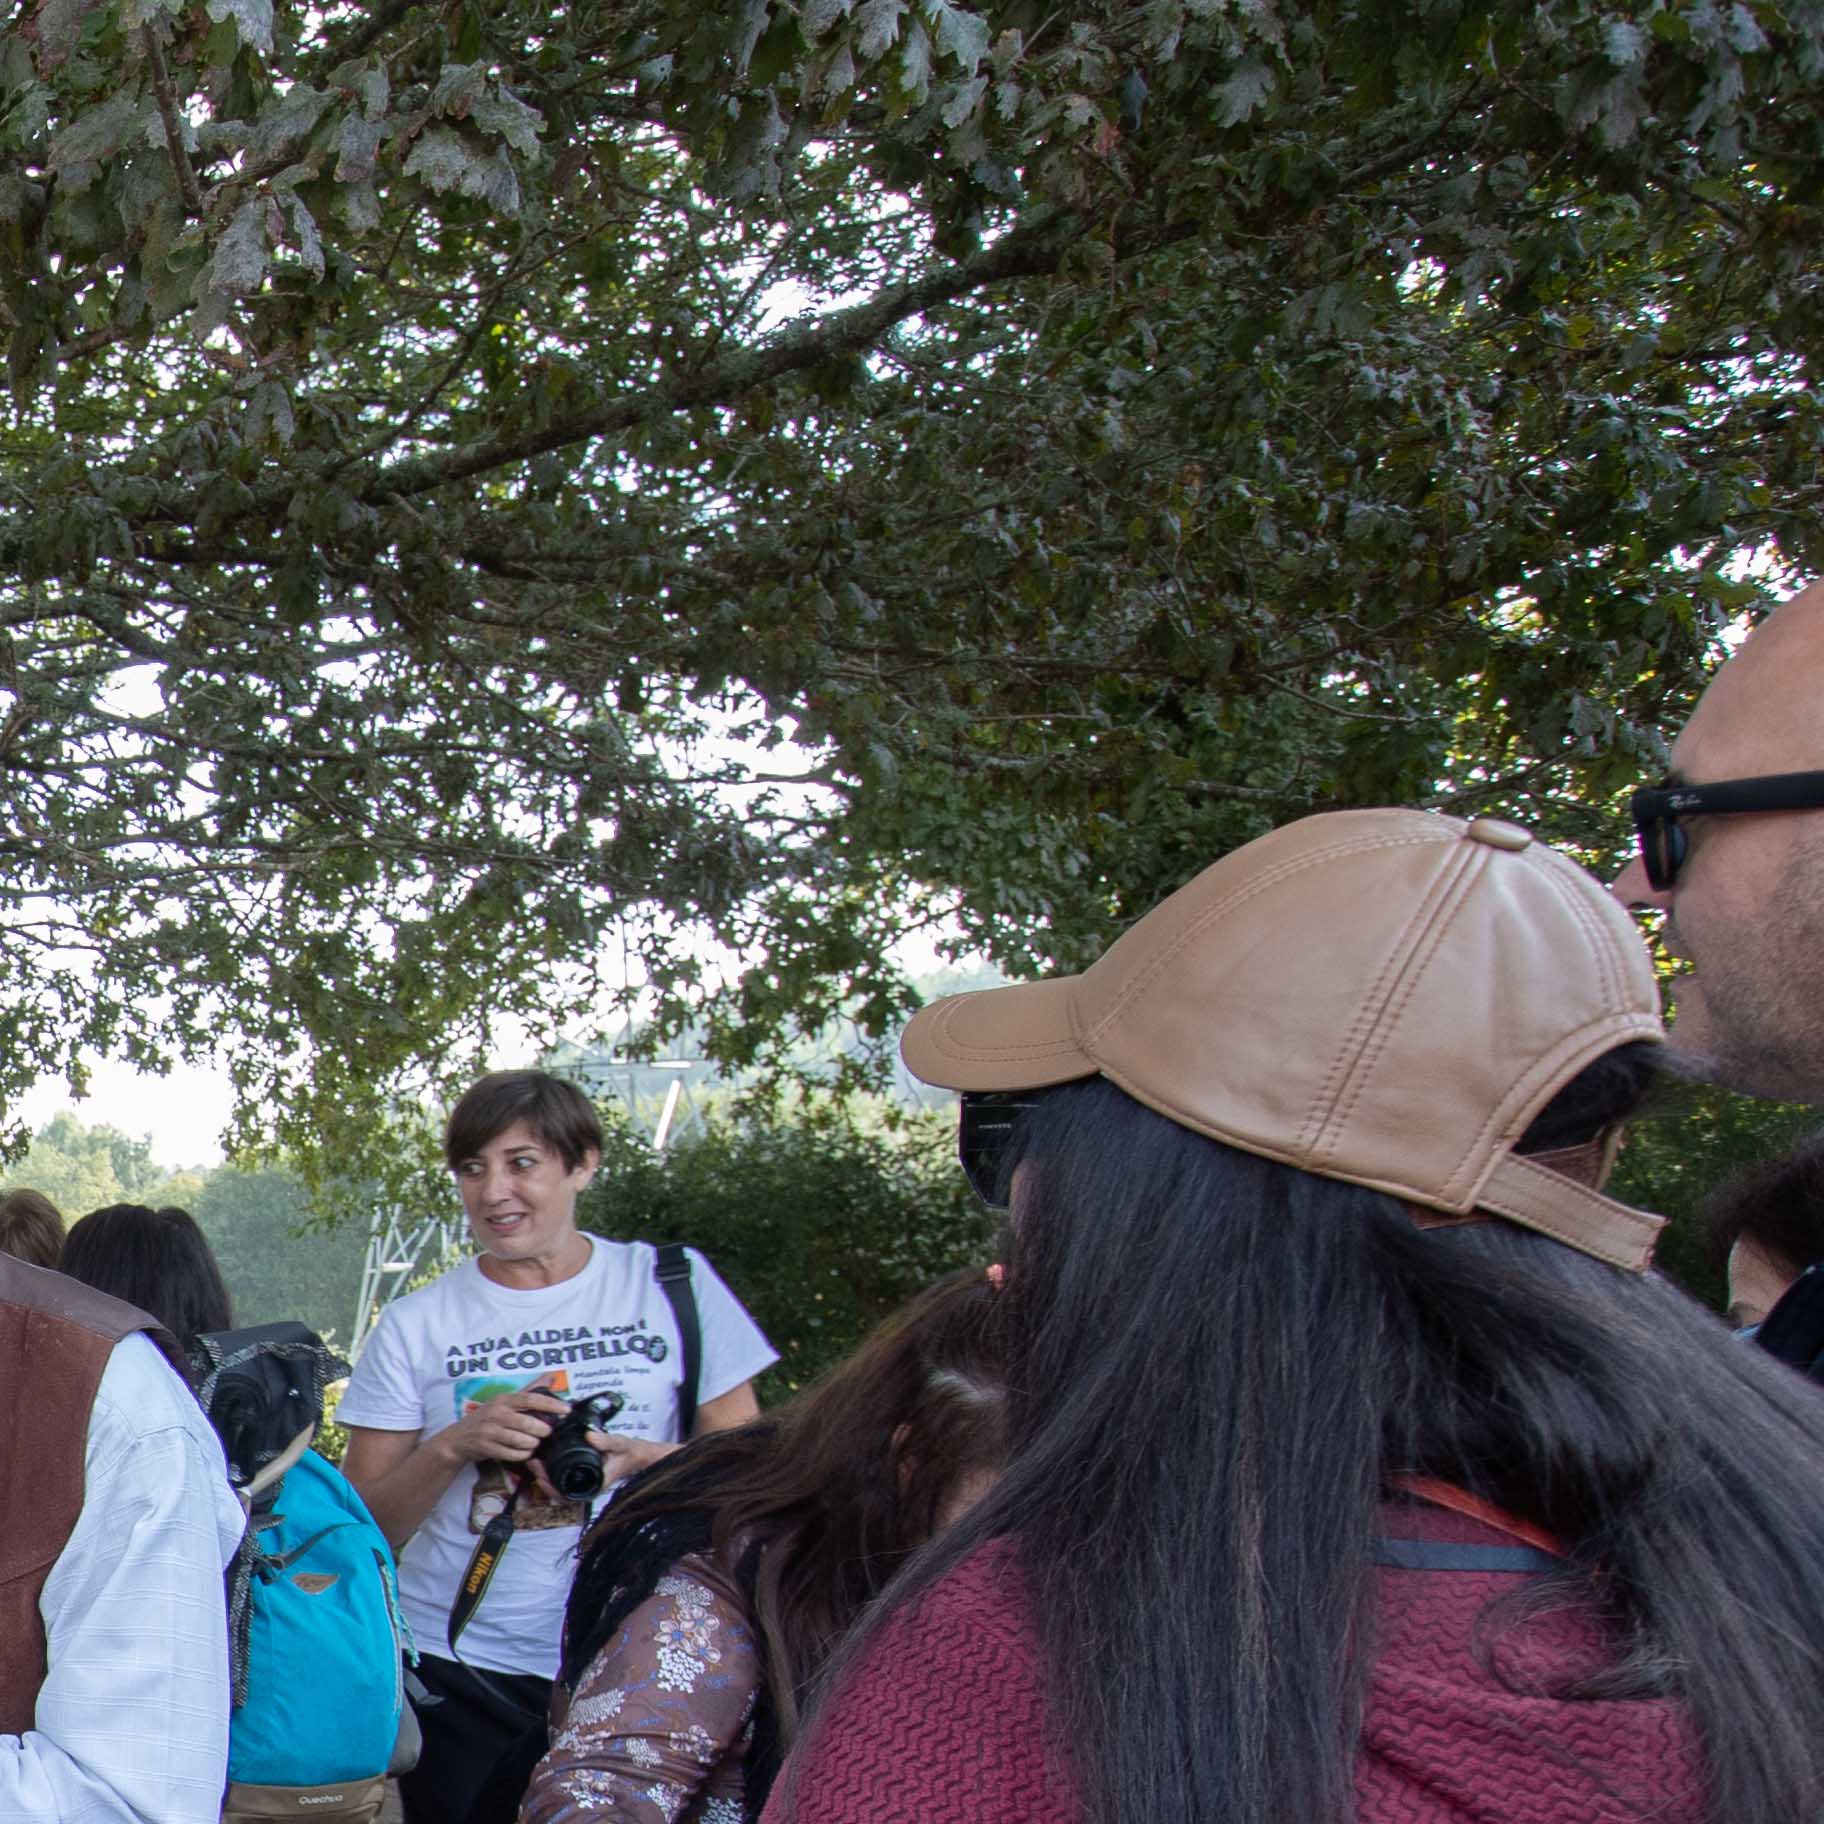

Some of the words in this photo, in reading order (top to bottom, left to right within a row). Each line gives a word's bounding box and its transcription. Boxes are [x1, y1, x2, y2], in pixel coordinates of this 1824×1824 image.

[447, 1345, 463, 1357] A
[466, 1337, 513, 1355] TÚA
[517, 1326, 593, 1347] ALDEA
[447, 1356, 489, 1378] UN
[497, 1334, 649, 1370] CORTELLO
[465, 1551, 494, 1595] Nikon
